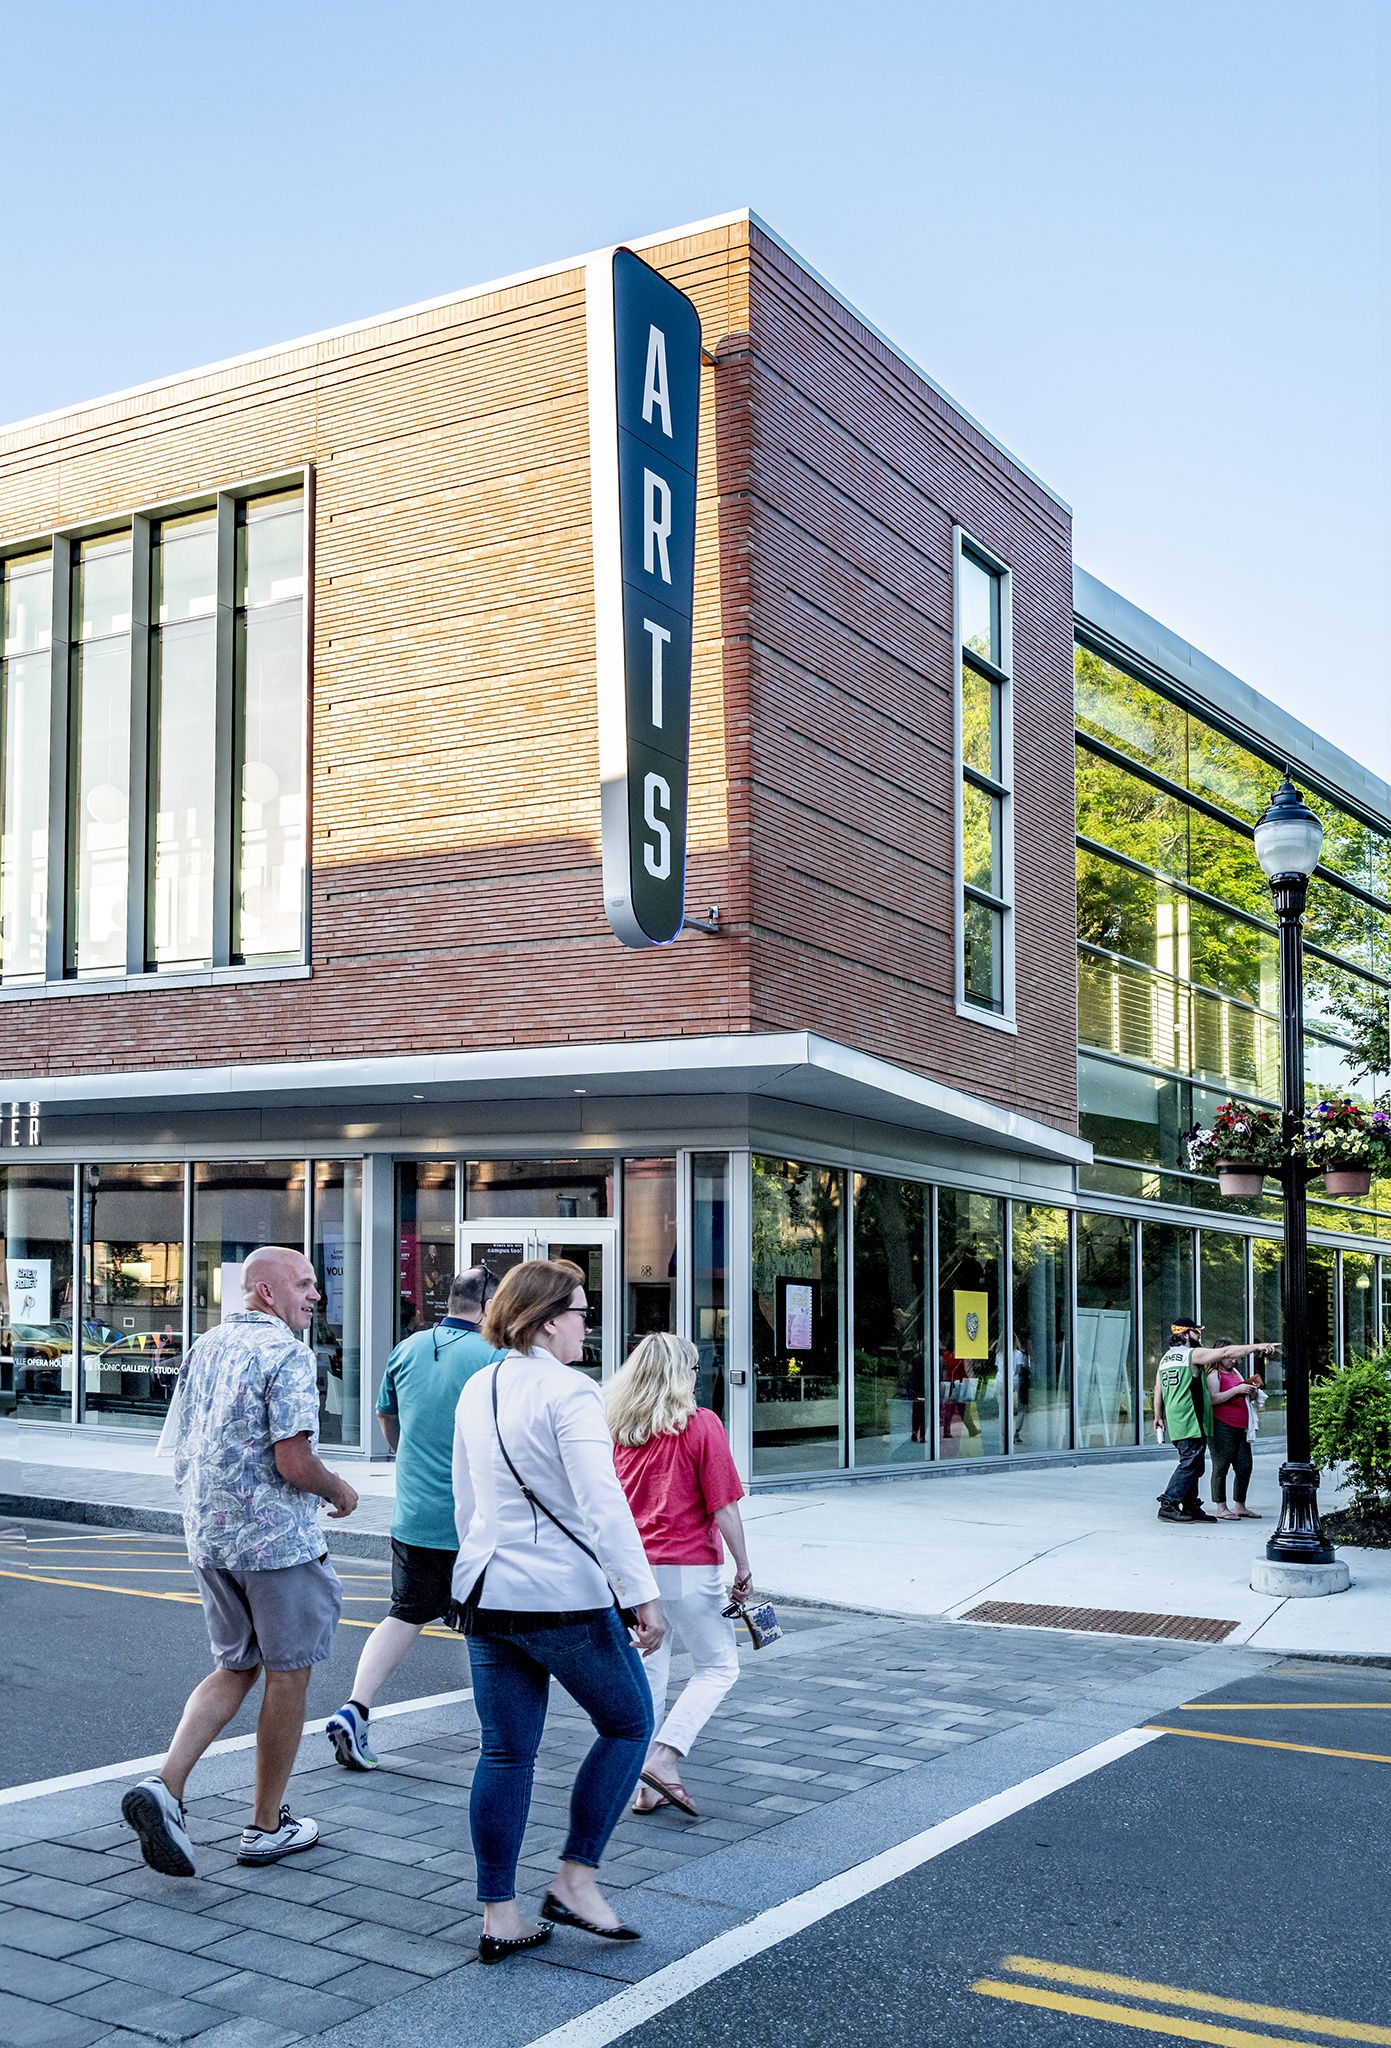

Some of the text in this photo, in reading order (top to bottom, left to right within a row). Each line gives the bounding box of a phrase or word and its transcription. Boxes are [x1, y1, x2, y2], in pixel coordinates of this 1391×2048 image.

[642, 324, 674, 881] ARTS
[0, 1118, 39, 1146] ER
[27, 1358, 48, 1367] OPERA
